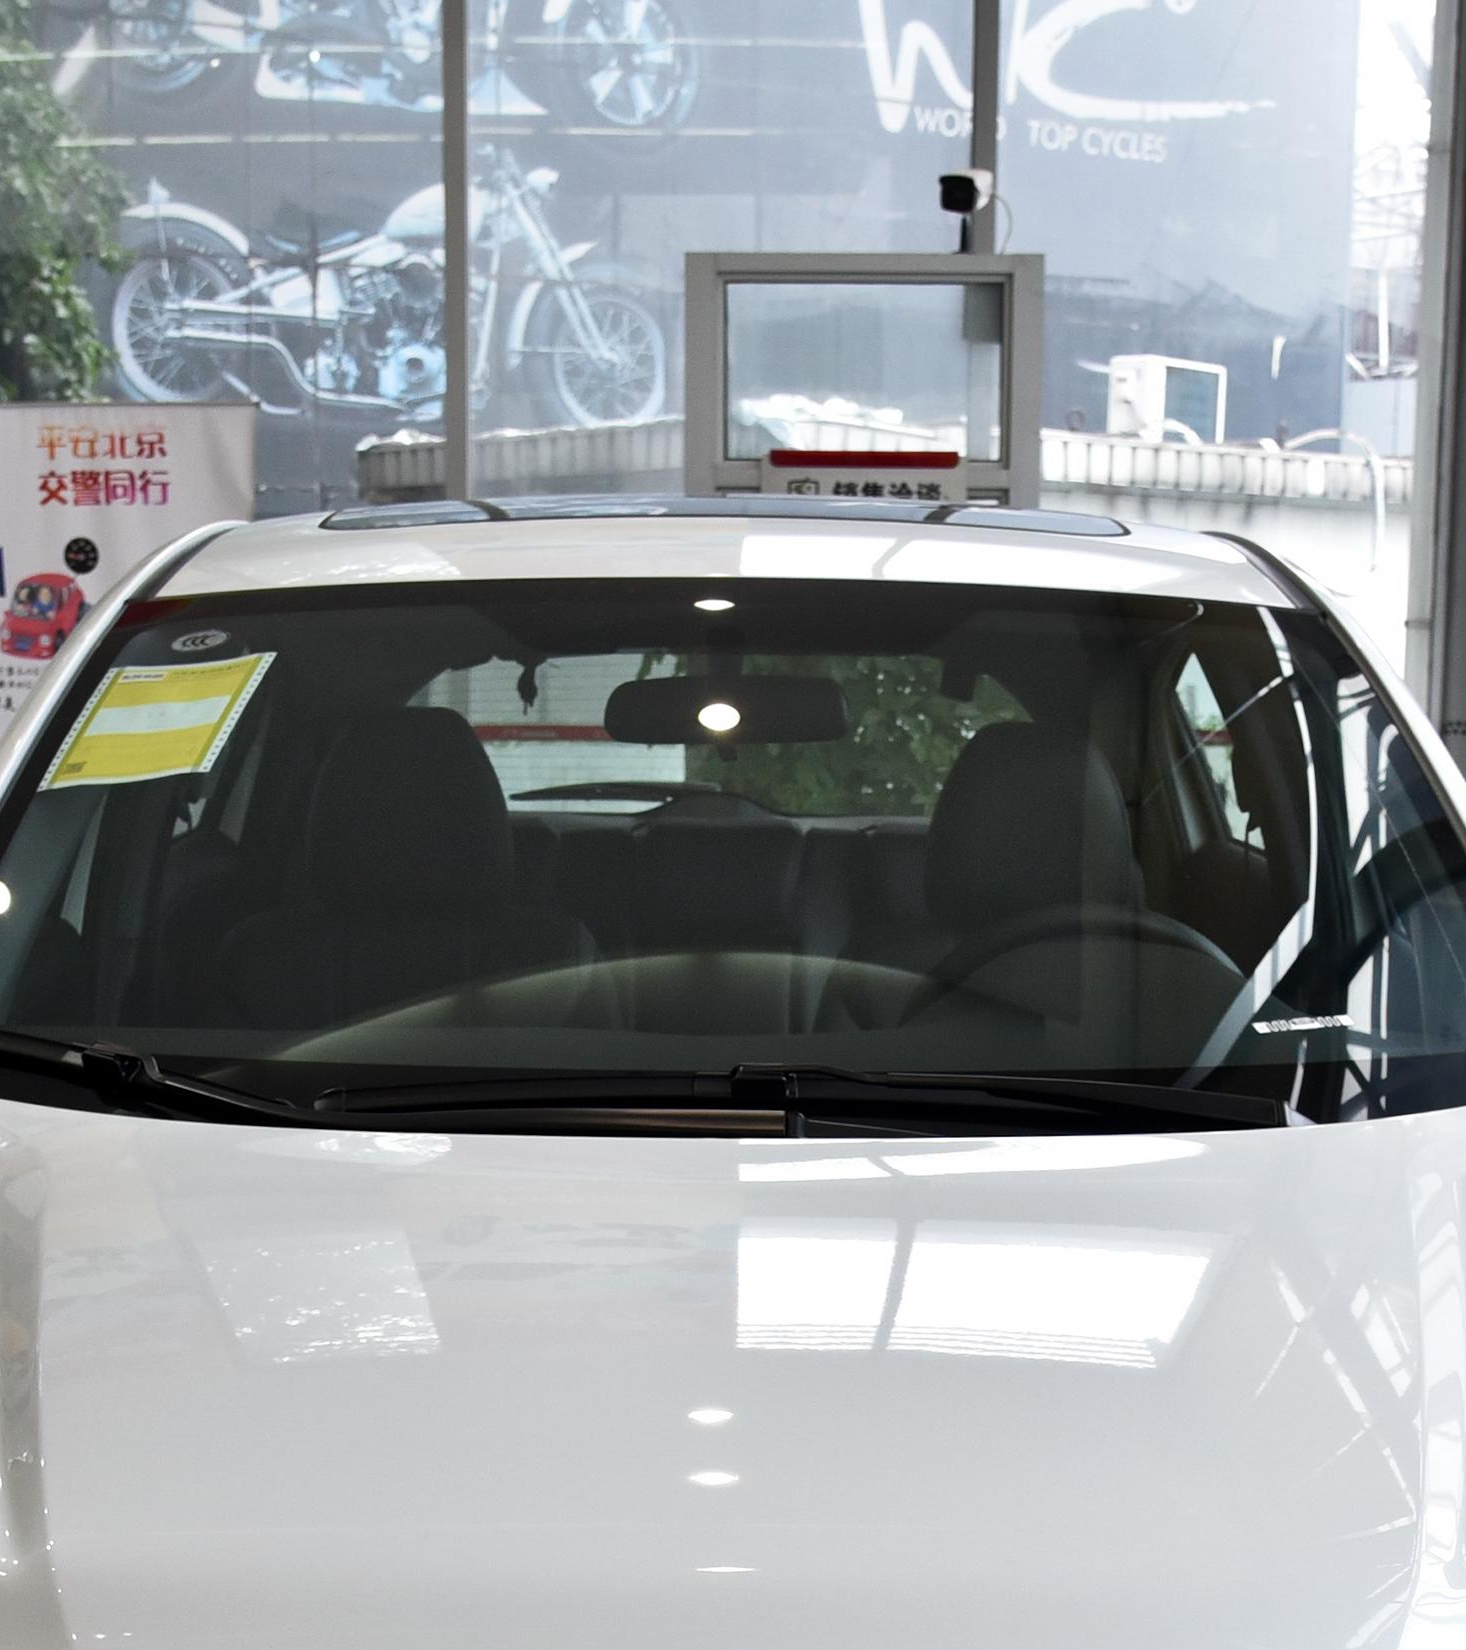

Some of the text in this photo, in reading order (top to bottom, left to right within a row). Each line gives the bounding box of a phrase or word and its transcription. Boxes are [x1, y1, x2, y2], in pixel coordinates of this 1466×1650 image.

[1028, 120, 1079, 152] TOP
[1082, 126, 1169, 163] CYCLES
[37, 424, 167, 460] 平安北京
[38, 469, 170, 506] 交警同行
